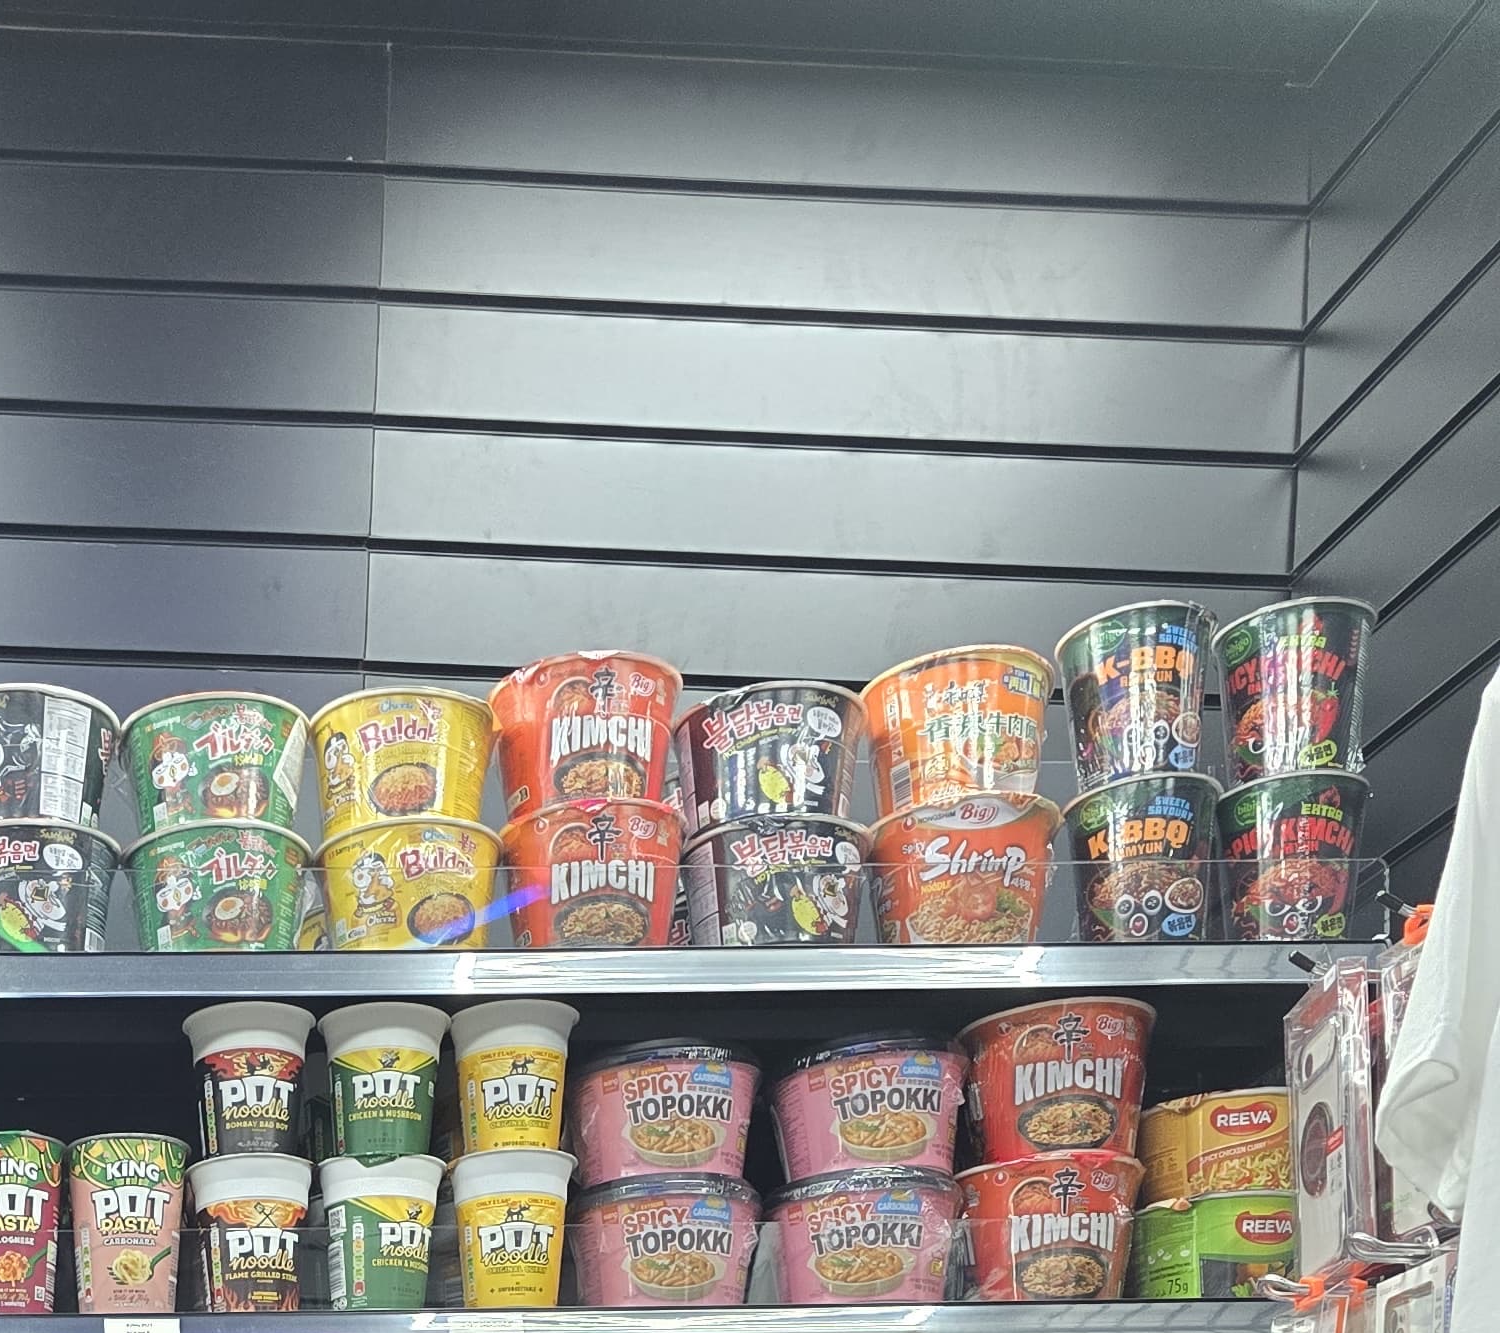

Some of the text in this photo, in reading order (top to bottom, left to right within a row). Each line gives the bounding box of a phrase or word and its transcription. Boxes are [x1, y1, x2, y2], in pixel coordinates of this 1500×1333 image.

[629, 673, 651, 692] Big
[702, 703, 804, 752] 불닭볶음면
[587, 814, 623, 861] 辛
[921, 837, 1027, 888] Shrimp
[551, 860, 653, 903] KIMCHI
[624, 1074, 687, 1100] SPICY
[222, 1099, 290, 1120] noodle
[625, 1095, 732, 1125] TOPOKKI
[1217, 1111, 1272, 1127] REEVA
[226, 1120, 257, 1130] BOMBAY
[1167, 1278, 1188, 1295] 75g
